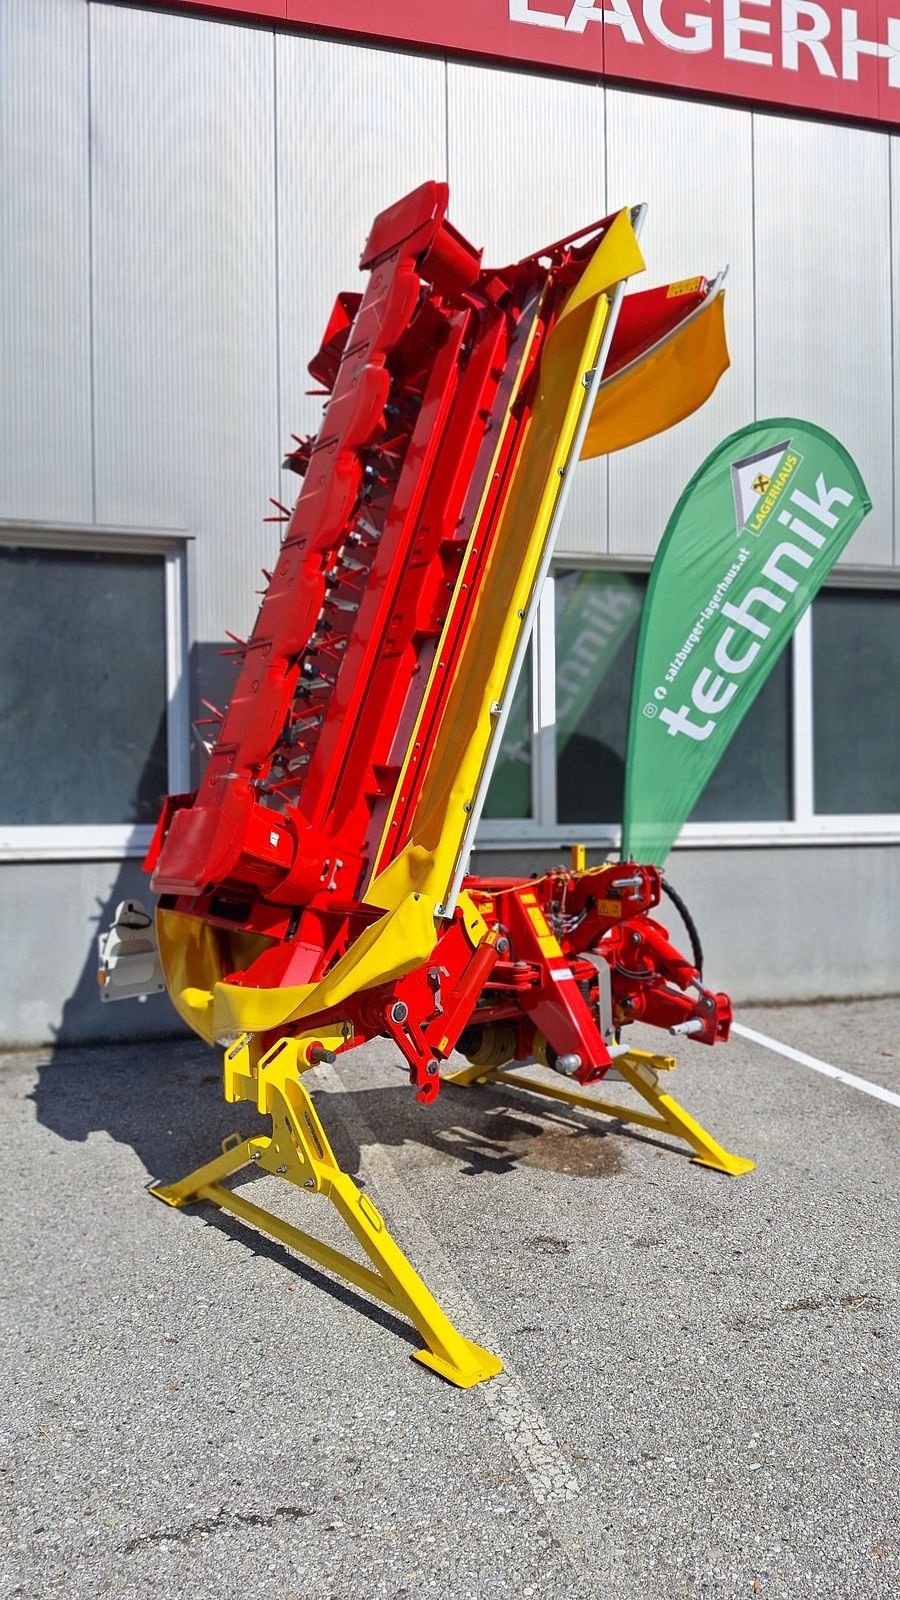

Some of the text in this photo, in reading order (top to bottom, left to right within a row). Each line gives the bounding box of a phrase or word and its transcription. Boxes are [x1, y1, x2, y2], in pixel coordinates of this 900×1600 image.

[750, 454, 798, 530] LAGERHAUS
[659, 473, 854, 741] technik
[665, 546, 751, 683] salzburger-lagerhaus.at
